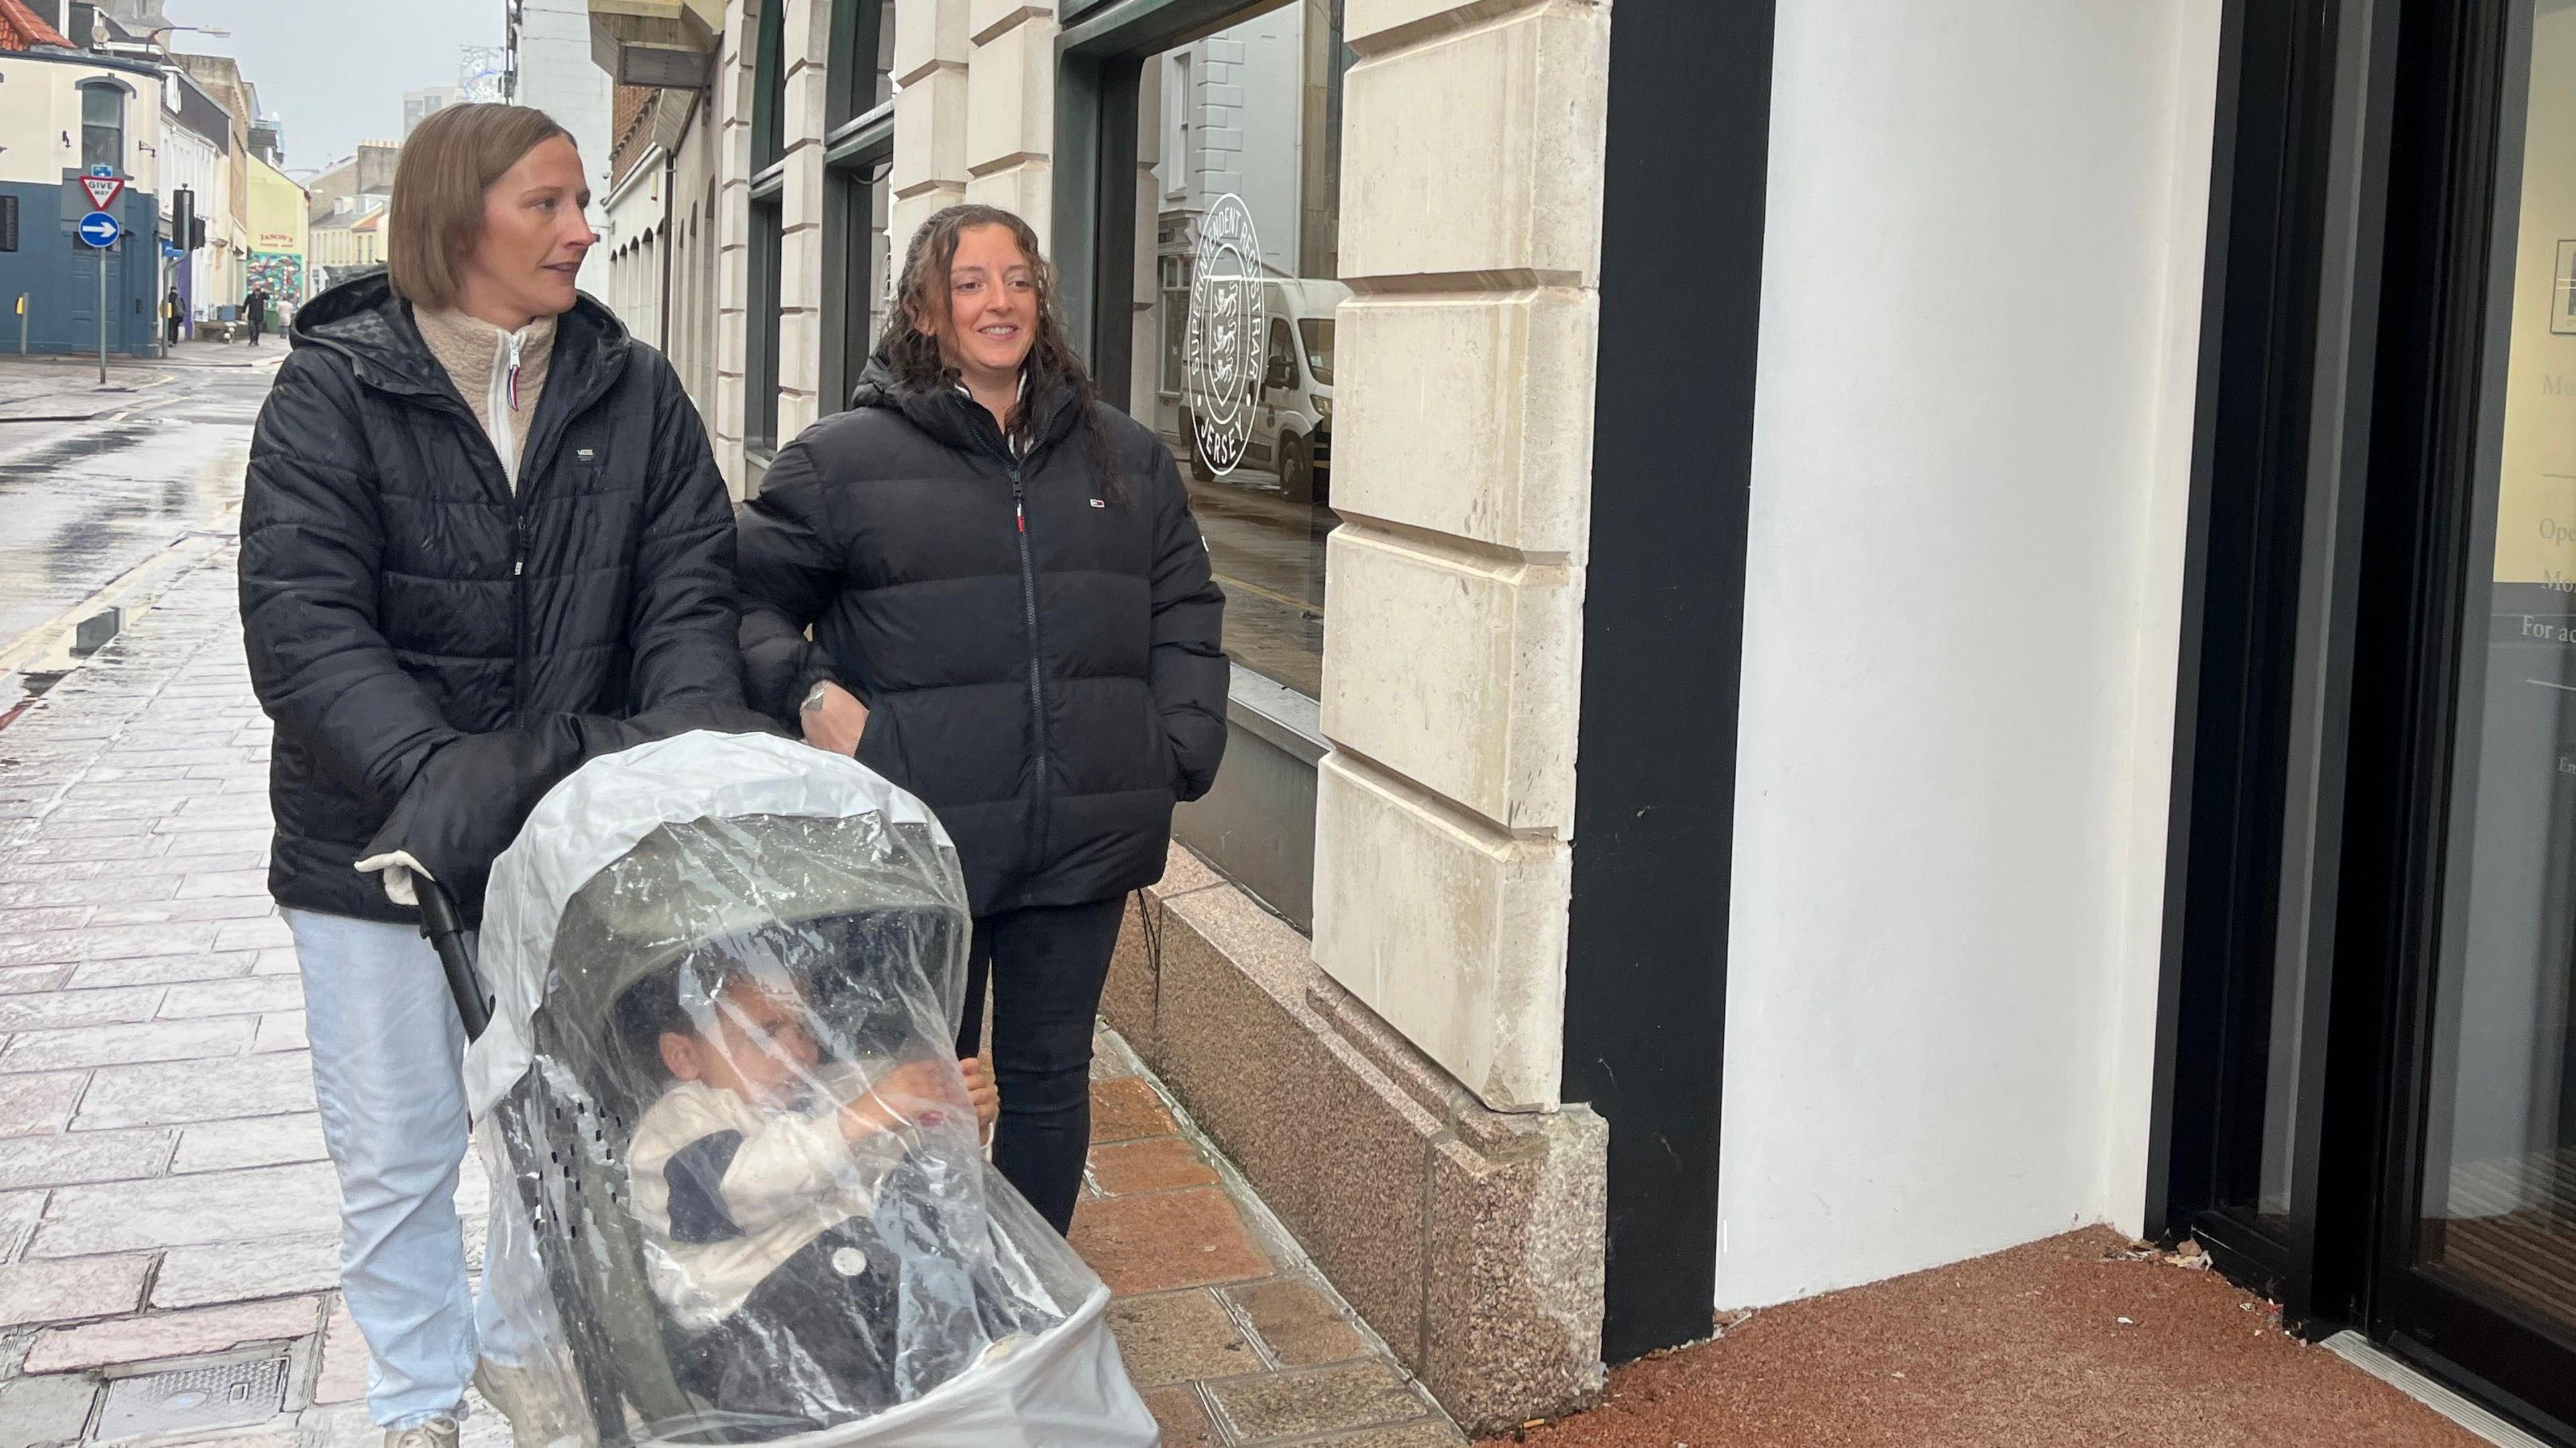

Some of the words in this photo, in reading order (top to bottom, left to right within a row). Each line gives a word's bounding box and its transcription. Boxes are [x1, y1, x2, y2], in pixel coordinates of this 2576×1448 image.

[89, 181, 113, 189] GIVE
[1191, 207, 1241, 376] SUPERINTENDENT
[1240, 221, 1261, 380] REGISTRAR
[1201, 411, 1243, 464] JERSEY
[2540, 569, 2576, 593] Mo
[2522, 615, 2553, 639] For
